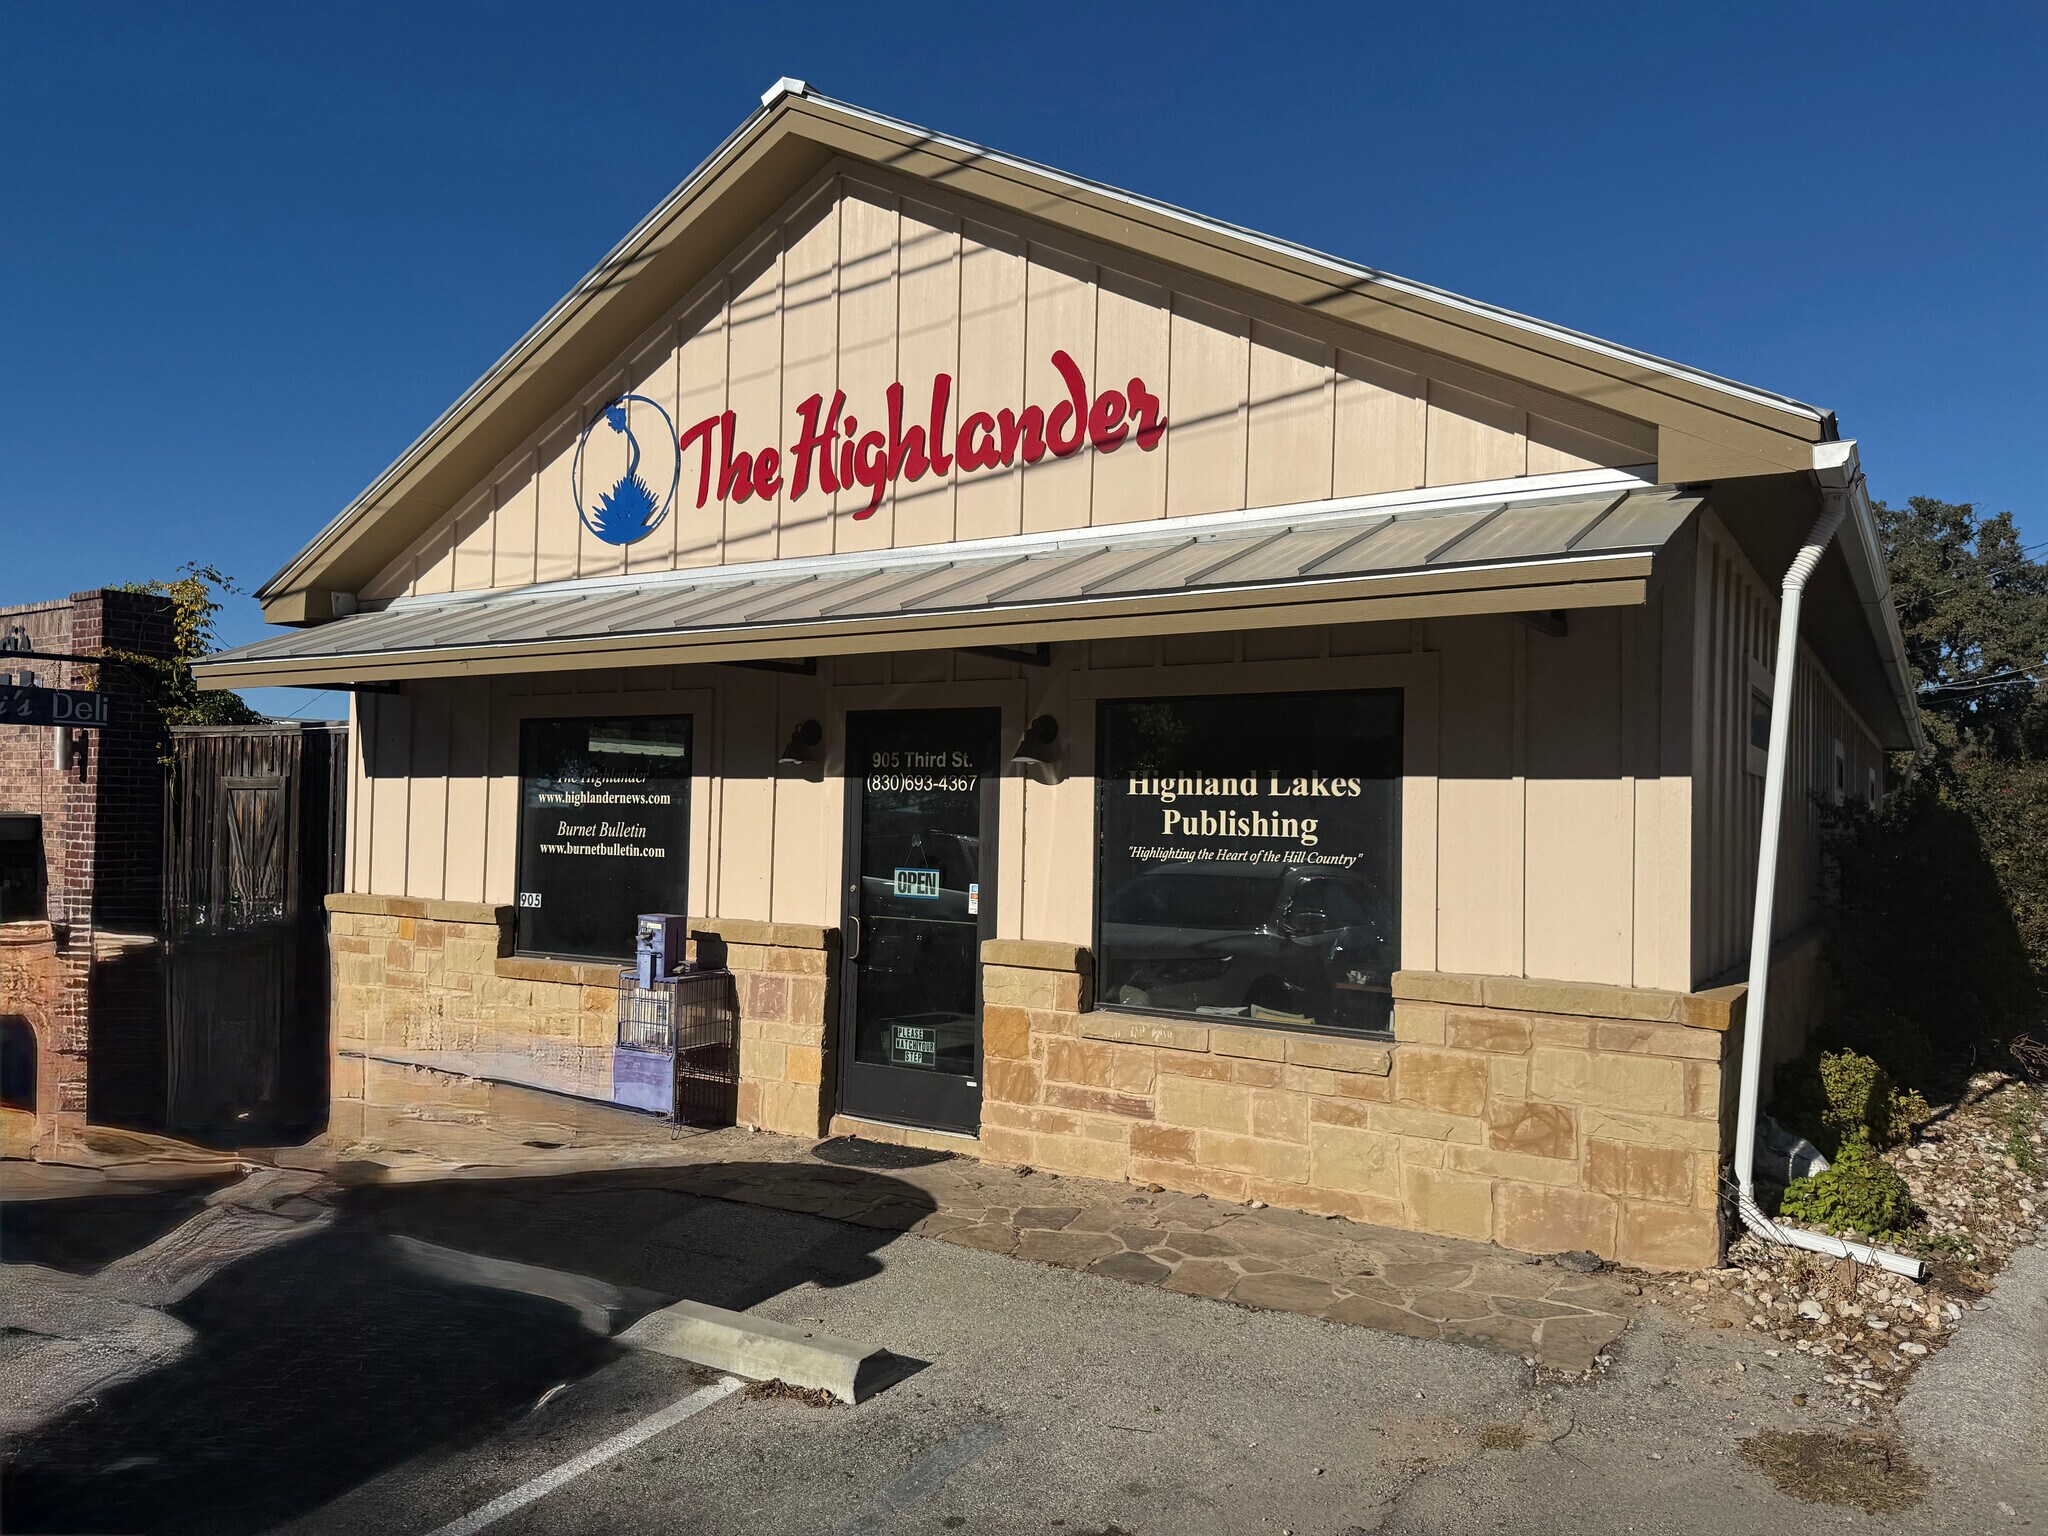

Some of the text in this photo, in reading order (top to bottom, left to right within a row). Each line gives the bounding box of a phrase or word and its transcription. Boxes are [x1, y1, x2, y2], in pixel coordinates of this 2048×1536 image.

[681, 350, 1168, 521] The Highlander
[52, 692, 109, 721] Deli
[872, 751, 973, 768] 905 Third St.
[558, 767, 650, 787] The Highlander
[867, 773, 978, 793] (830)693-4367
[1127, 770, 1362, 802] Highland Lakes
[538, 790, 671, 807] www.highlandernews.com
[557, 821, 647, 838] Burnet Bulletin
[1161, 809, 1319, 845] Publishing
[540, 842, 666, 858] www.burnetbulletin.com
[1128, 846, 1364, 868] "Highlighting the Heart of the Hill Country"
[898, 871, 936, 895] OPEN
[521, 894, 541, 907] 905
[898, 1028, 923, 1038] PLEASE
[896, 1039, 934, 1052] WATCH YOUR
[905, 1052, 922, 1062] STEP
